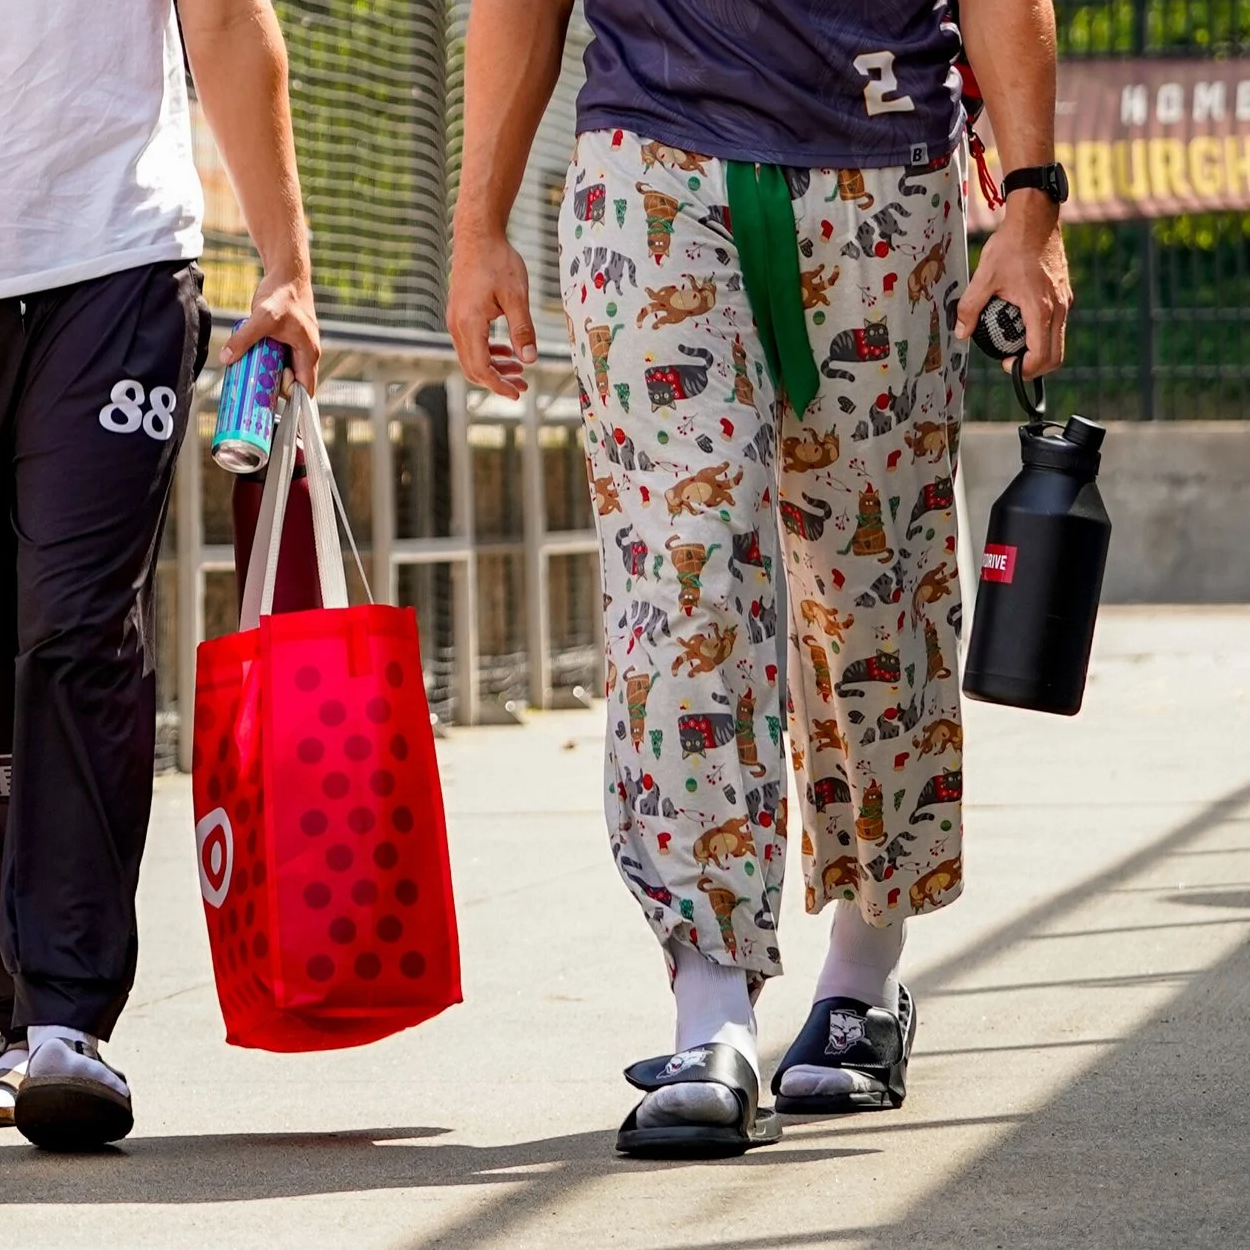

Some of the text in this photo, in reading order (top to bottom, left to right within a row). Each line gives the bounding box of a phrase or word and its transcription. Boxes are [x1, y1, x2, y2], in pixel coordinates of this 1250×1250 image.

[853, 51, 915, 116] 2
[913, 148, 923, 162] B
[99, 379, 177, 440] 88
